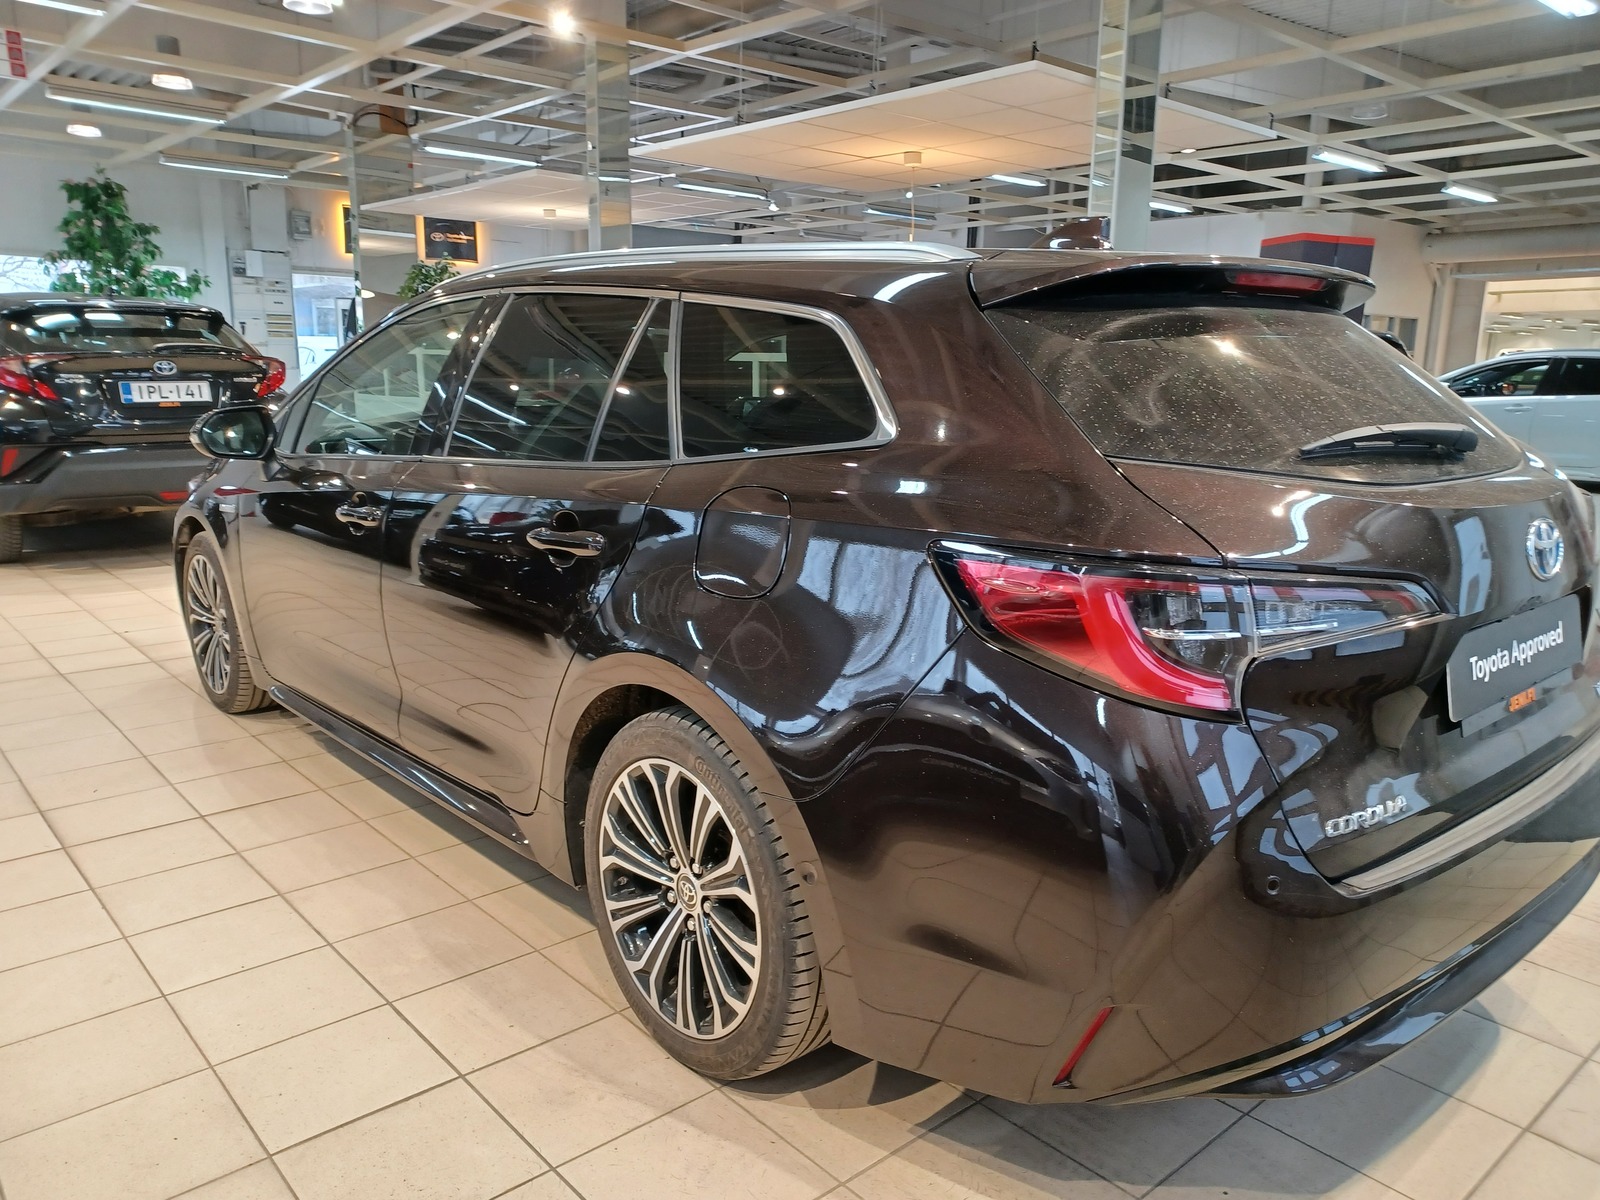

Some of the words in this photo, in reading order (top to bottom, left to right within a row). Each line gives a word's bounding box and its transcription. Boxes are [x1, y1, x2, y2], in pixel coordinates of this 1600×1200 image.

[138, 385, 203, 400] IPL-141
[1469, 648, 1510, 682] Toyota
[1511, 620, 1563, 666] Approved
[1325, 795, 1408, 838] COROLLA
